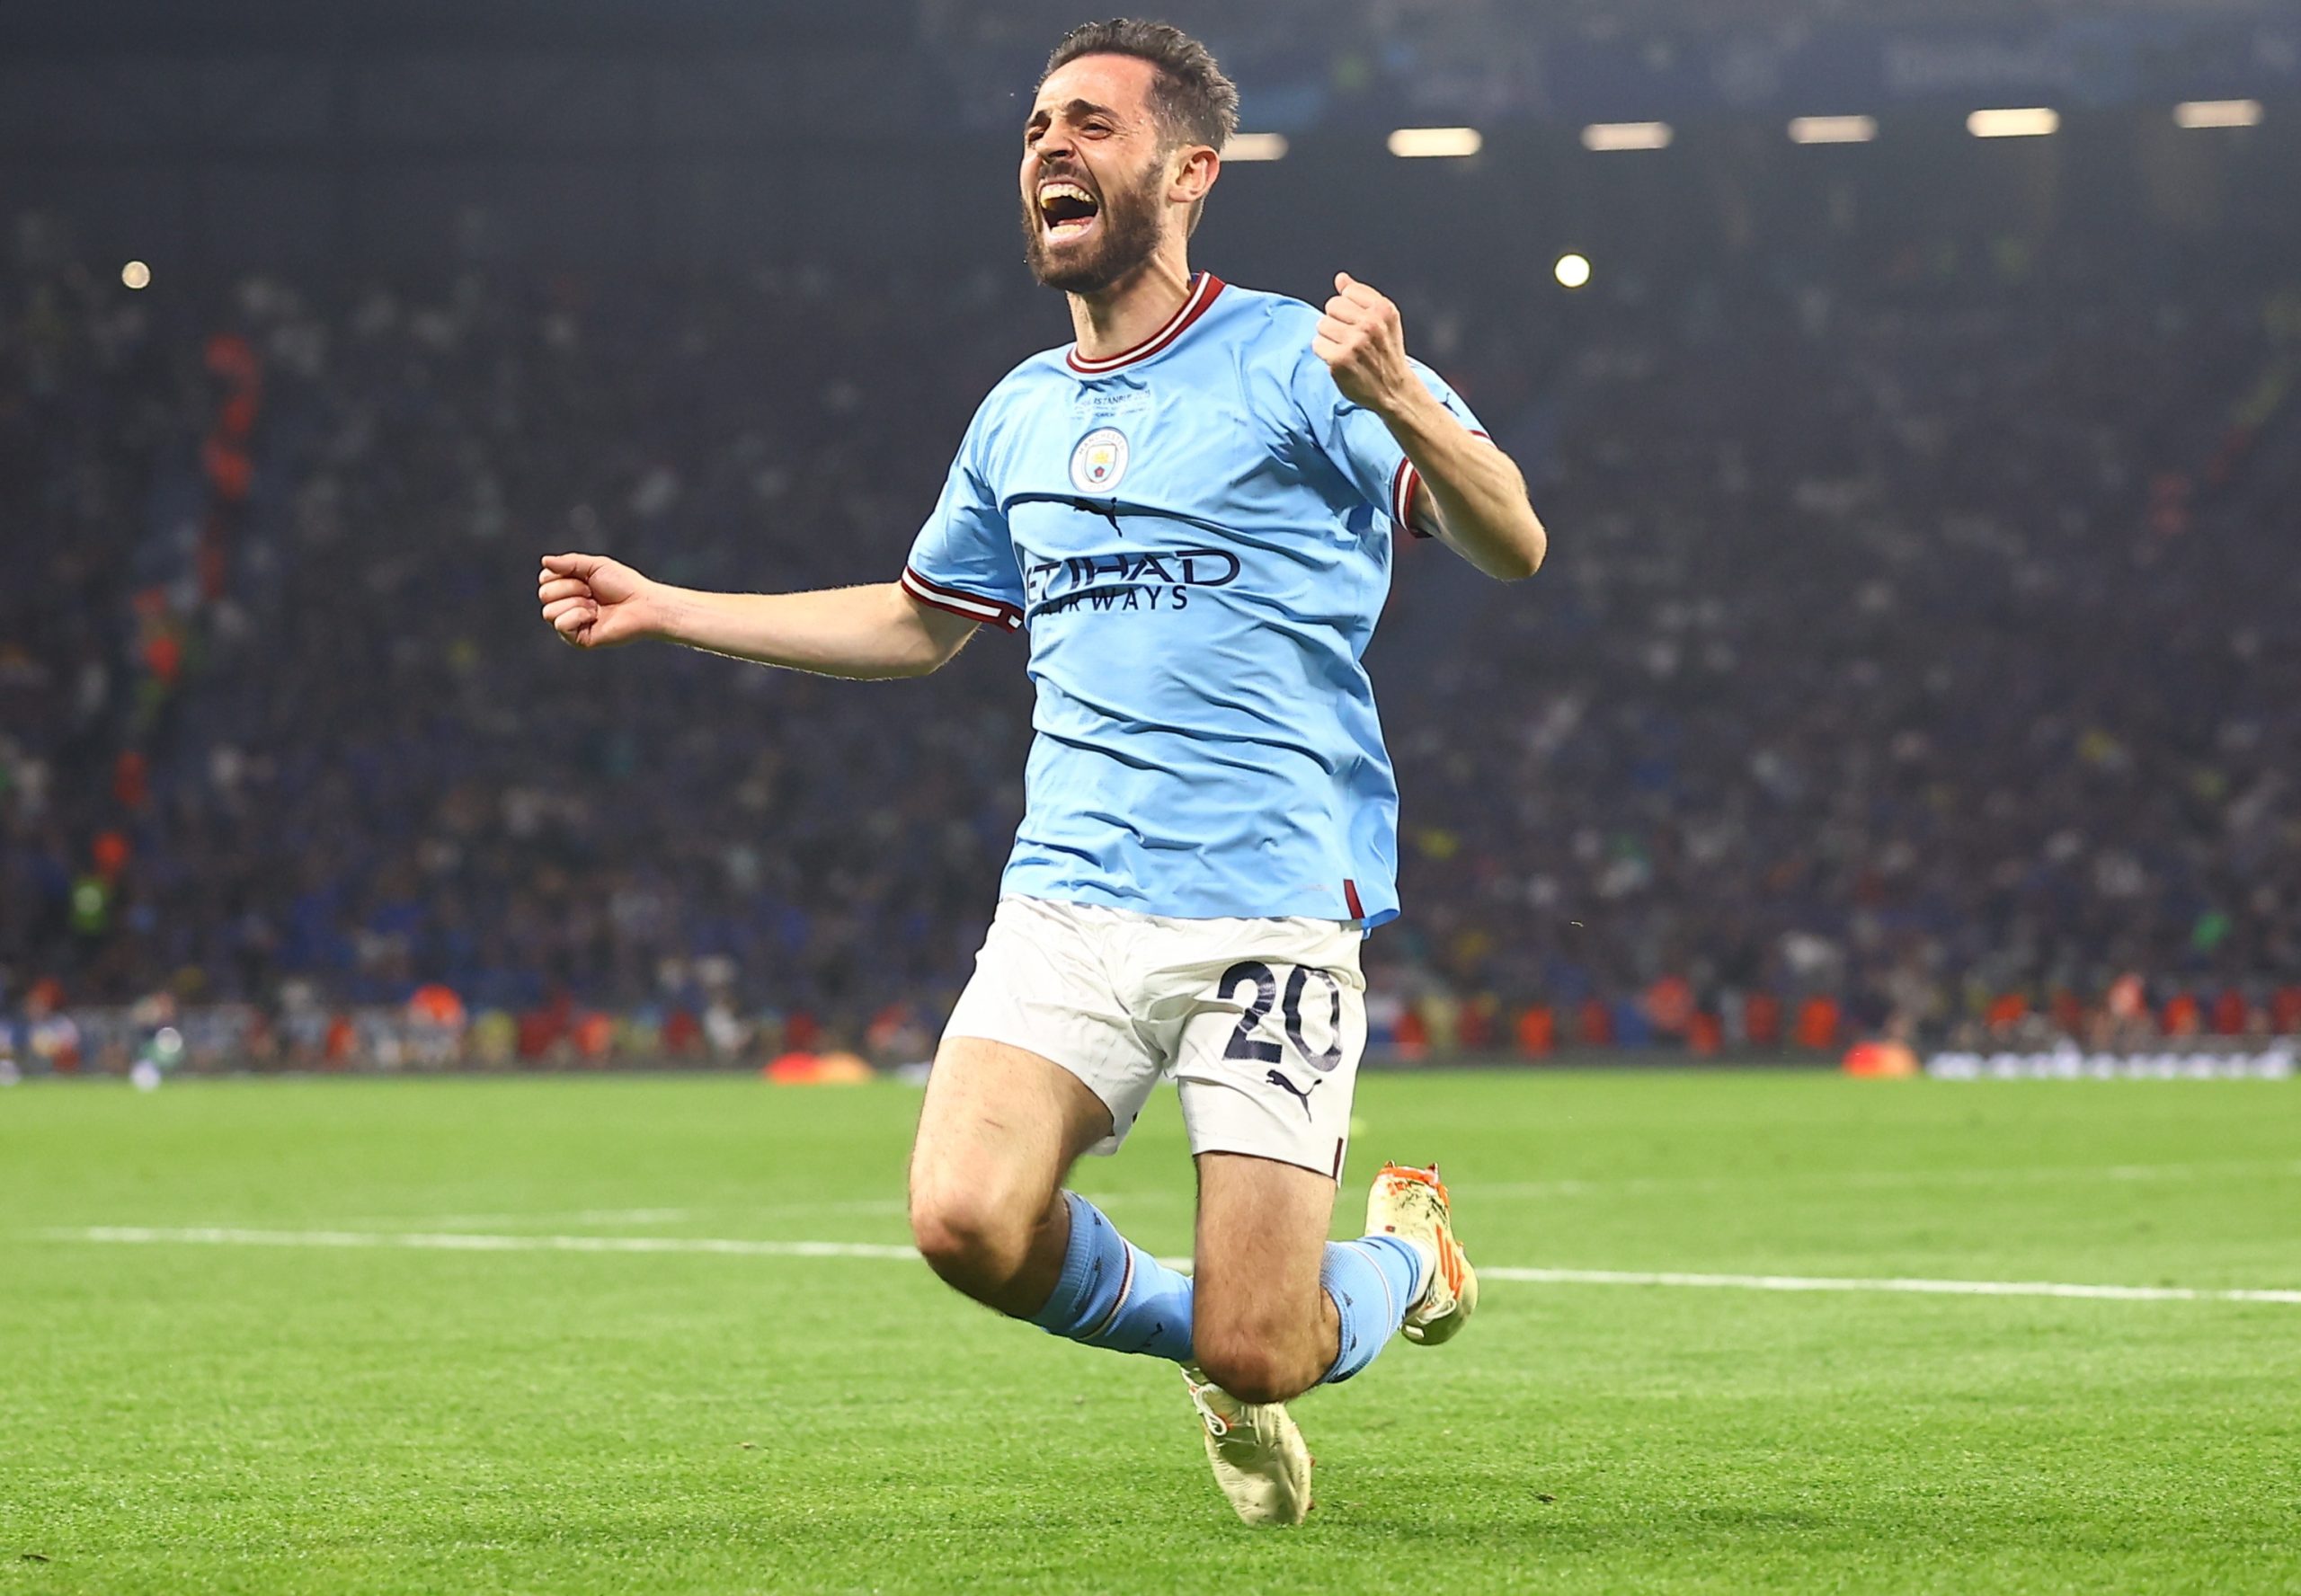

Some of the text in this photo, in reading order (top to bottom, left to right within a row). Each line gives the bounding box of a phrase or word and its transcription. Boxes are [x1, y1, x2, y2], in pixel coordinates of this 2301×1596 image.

[1026, 548, 1240, 605] ETIHAD
[1041, 585, 1188, 616] AIRWAYS
[1216, 961, 1344, 1072] 20
